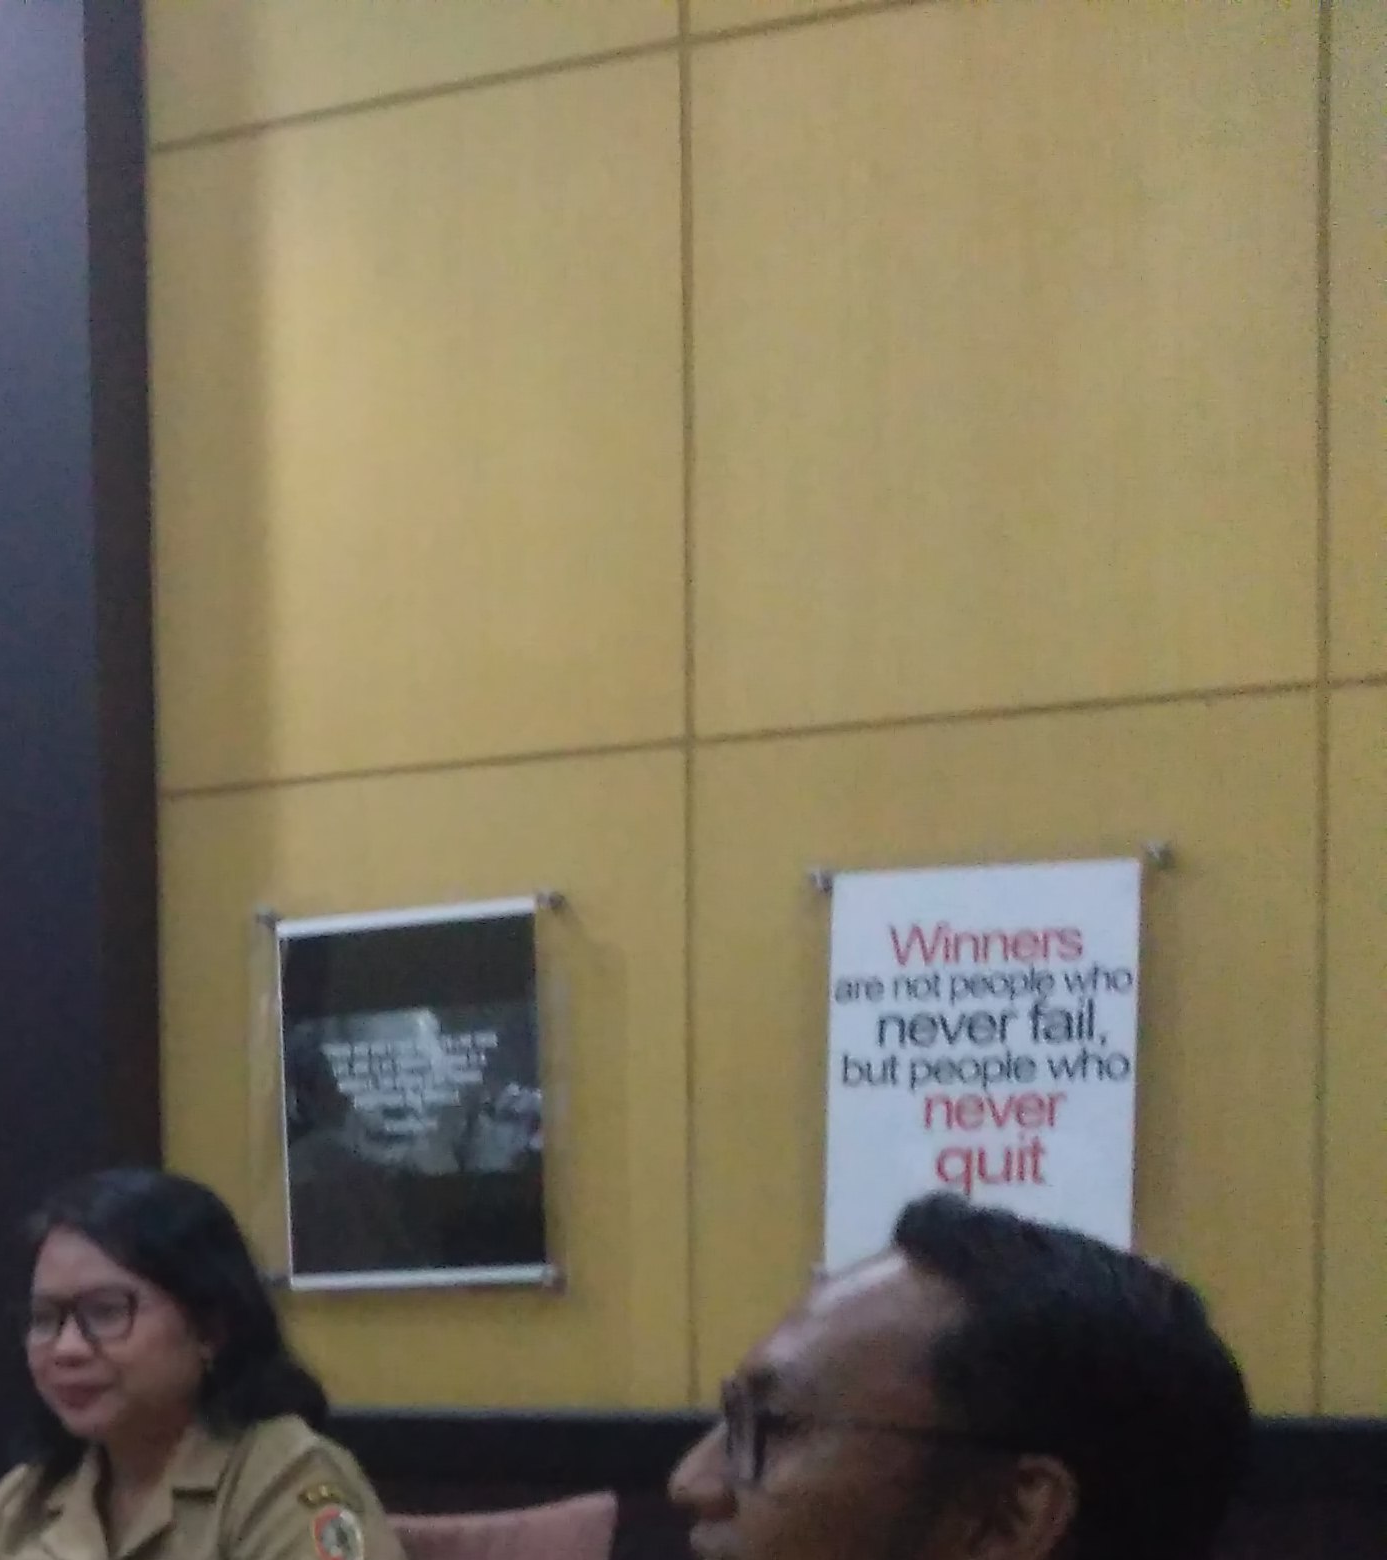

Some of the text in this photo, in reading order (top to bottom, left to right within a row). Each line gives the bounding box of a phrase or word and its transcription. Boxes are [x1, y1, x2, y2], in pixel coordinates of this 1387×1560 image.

[888, 920, 1083, 967] Winners
[834, 960, 1133, 1005] are not people who
[877, 998, 1107, 1049] never fail,
[841, 1047, 1131, 1092] but people who
[924, 1089, 1068, 1131] never
[934, 1133, 1048, 1197] quit
